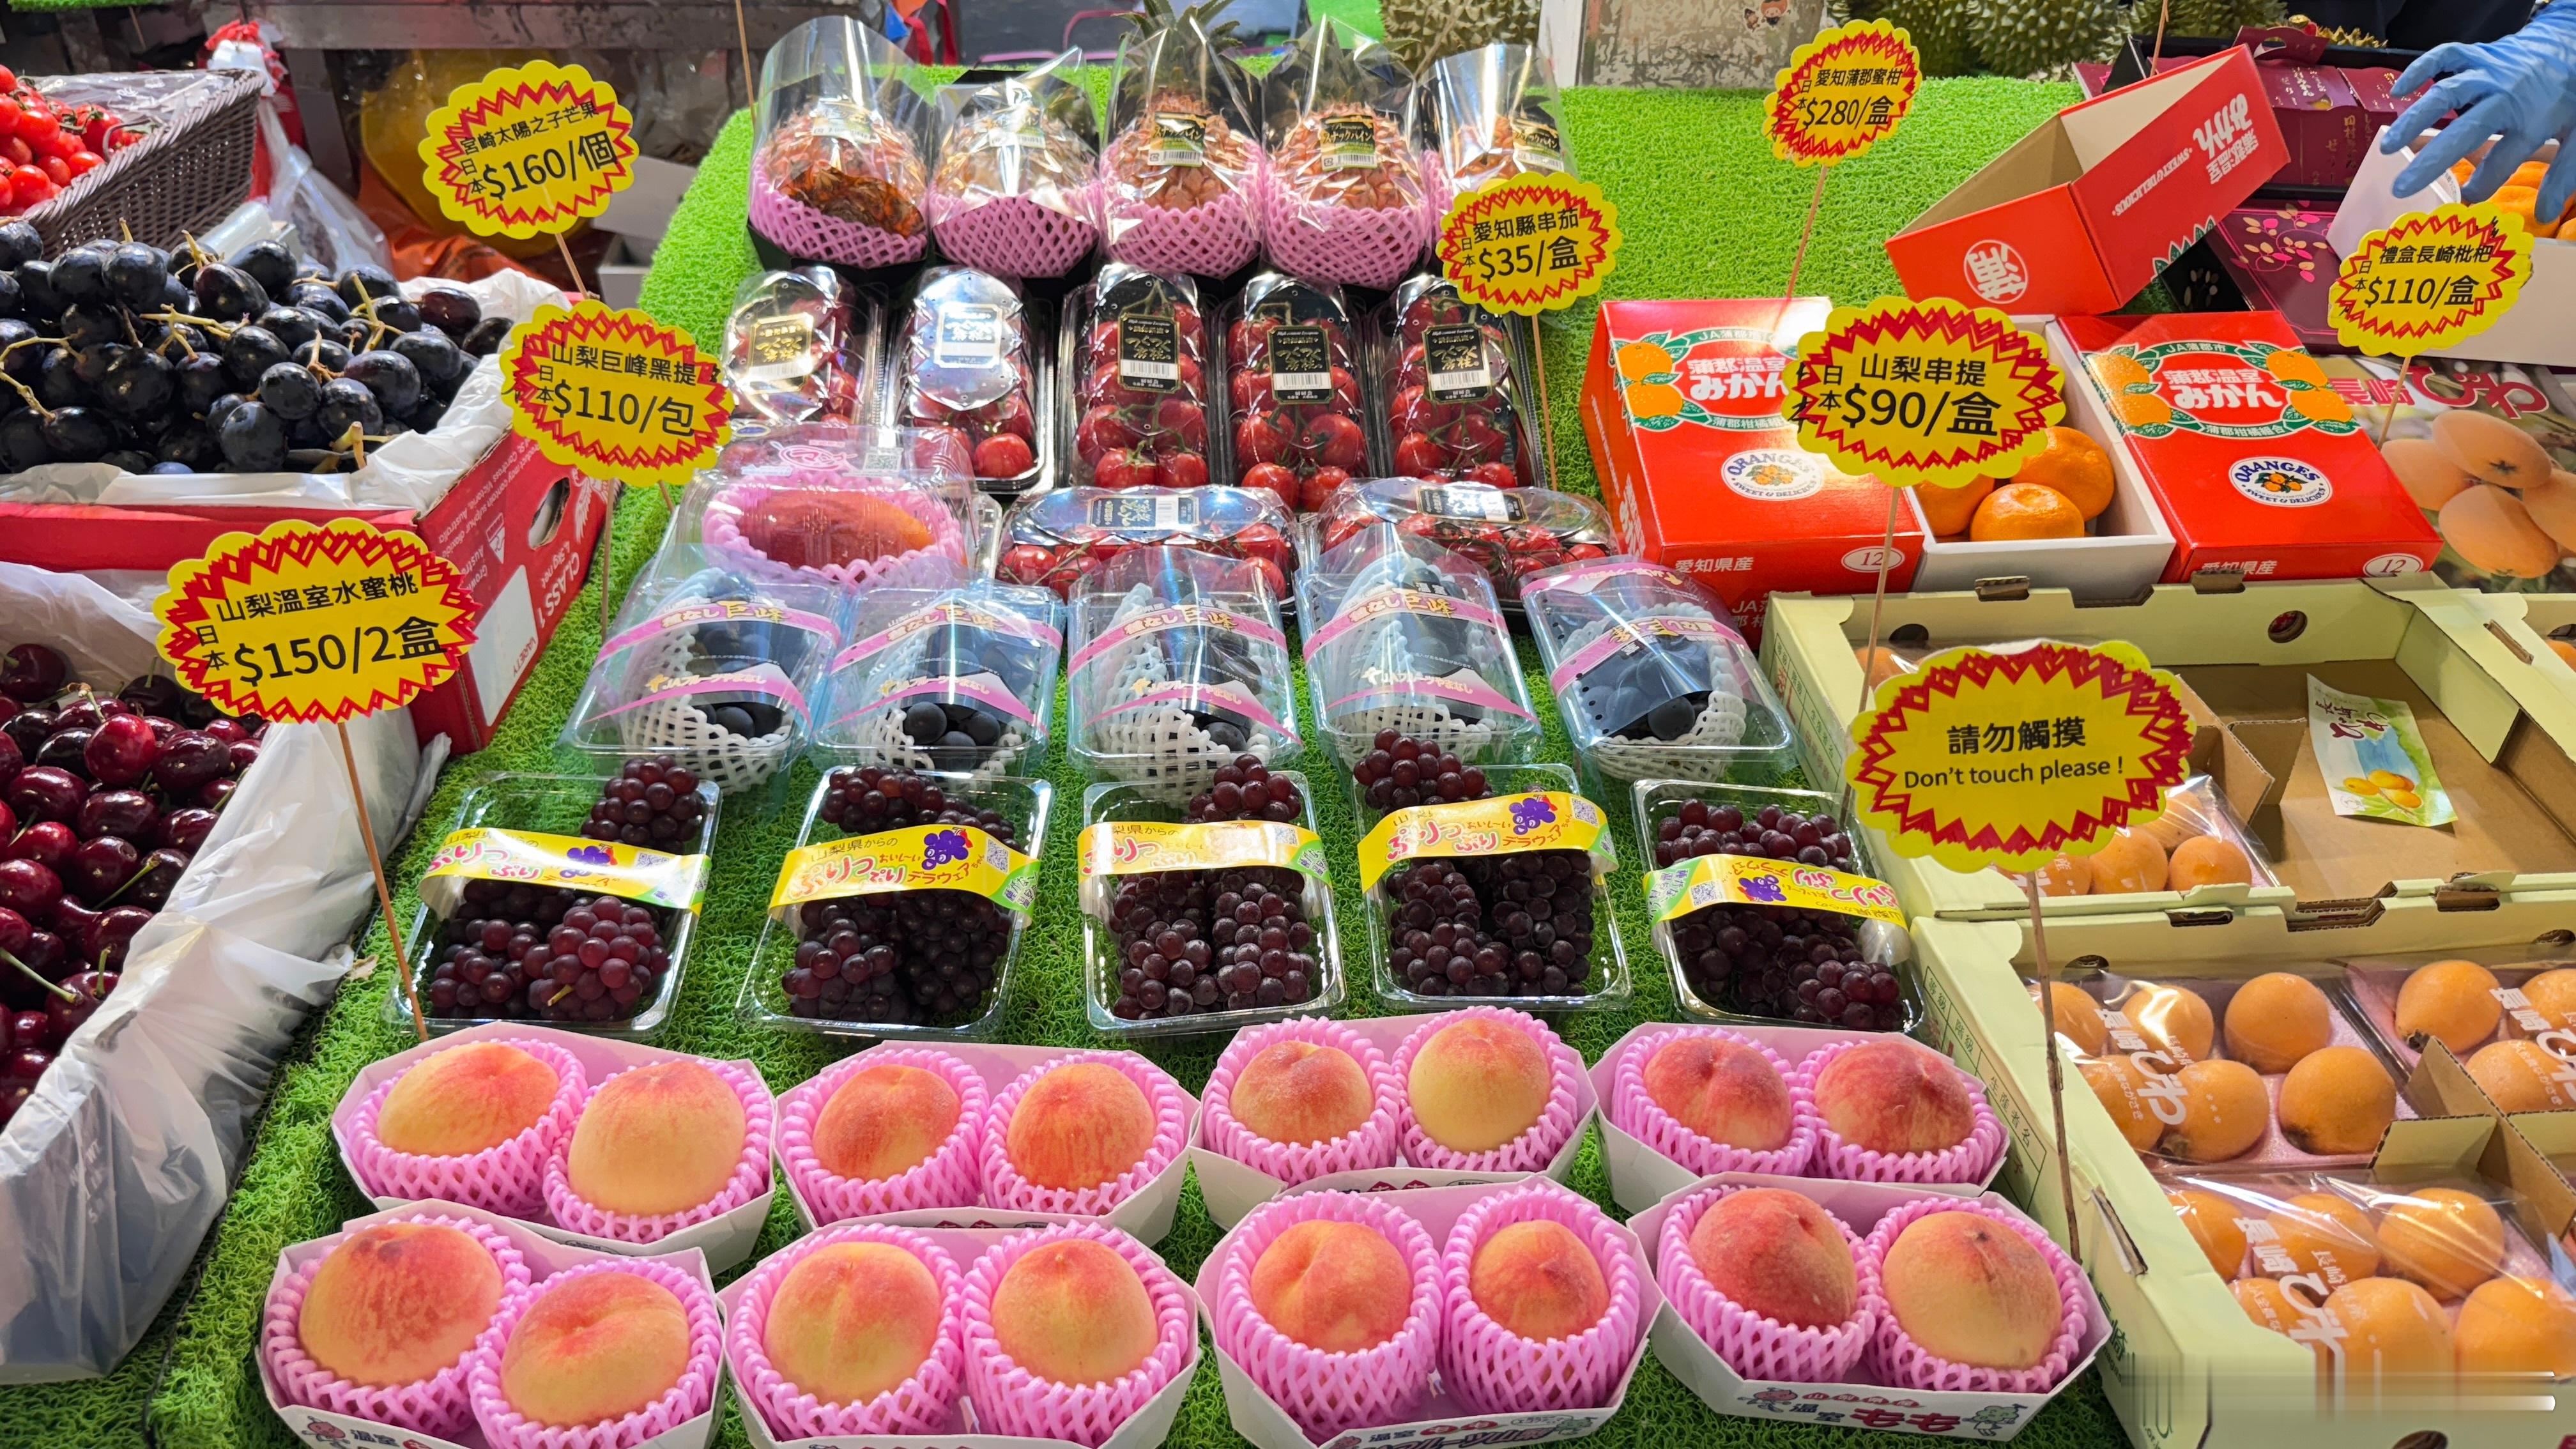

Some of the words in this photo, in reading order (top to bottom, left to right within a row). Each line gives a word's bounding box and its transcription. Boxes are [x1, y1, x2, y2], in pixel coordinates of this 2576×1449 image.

[1814, 68, 1903, 88] 愛知蒲郡蜜柑
[1795, 80, 1812, 112] 日本
[1805, 96, 1894, 129] $280/盒
[460, 100, 598, 156] 宮崎太陽之子芒果
[2193, 93, 2252, 160] みかん
[461, 158, 487, 195] 日本
[483, 131, 618, 201] $160/個
[1473, 208, 1579, 243] 愛知縣串茄
[1461, 236, 1476, 268] 日本
[1478, 236, 1582, 282] $35/盒
[2379, 244, 2493, 266] 禮盒長崎枇杷
[2354, 261, 2373, 291] 日本
[2365, 275, 2481, 309] $110/盒
[2166, 342, 2227, 352] JA蒲郡市
[551, 346, 697, 386] 山梨巨峰黑提
[1687, 357, 1788, 374] 蒲郡温室
[1860, 353, 1986, 387] 山梨串提
[2162, 369, 2264, 385] 蒲郡温室
[537, 365, 555, 404] 日本
[1819, 365, 1843, 413] 日本
[2170, 383, 2283, 409] みかん
[553, 379, 695, 437] $110/包
[1841, 383, 2002, 438] $90/盒
[2204, 424, 2285, 437] 蒲郡柑橘組合
[2234, 461, 2320, 483] ORANGES
[1734, 481, 1763, 497] SWEET
[2245, 488, 2278, 503] SWEET
[2290, 487, 2326, 504] DELICIOUS
[1675, 556, 1754, 574] 愛知県産
[1860, 551, 1885, 567] 12
[2380, 559, 2407, 573] 12
[217, 572, 419, 623] 山梨溫室水蜜桃
[544, 552, 581, 617] CLASS
[195, 625, 230, 671] 日本
[233, 616, 447, 687] $150/2盒
[1947, 717, 2086, 756] 請勿觸摸
[1903, 765, 1965, 790] Don't
[1968, 762, 2035, 785] touch
[2039, 758, 2111, 785] please
[811, 838, 898, 862] 山梨県からの
